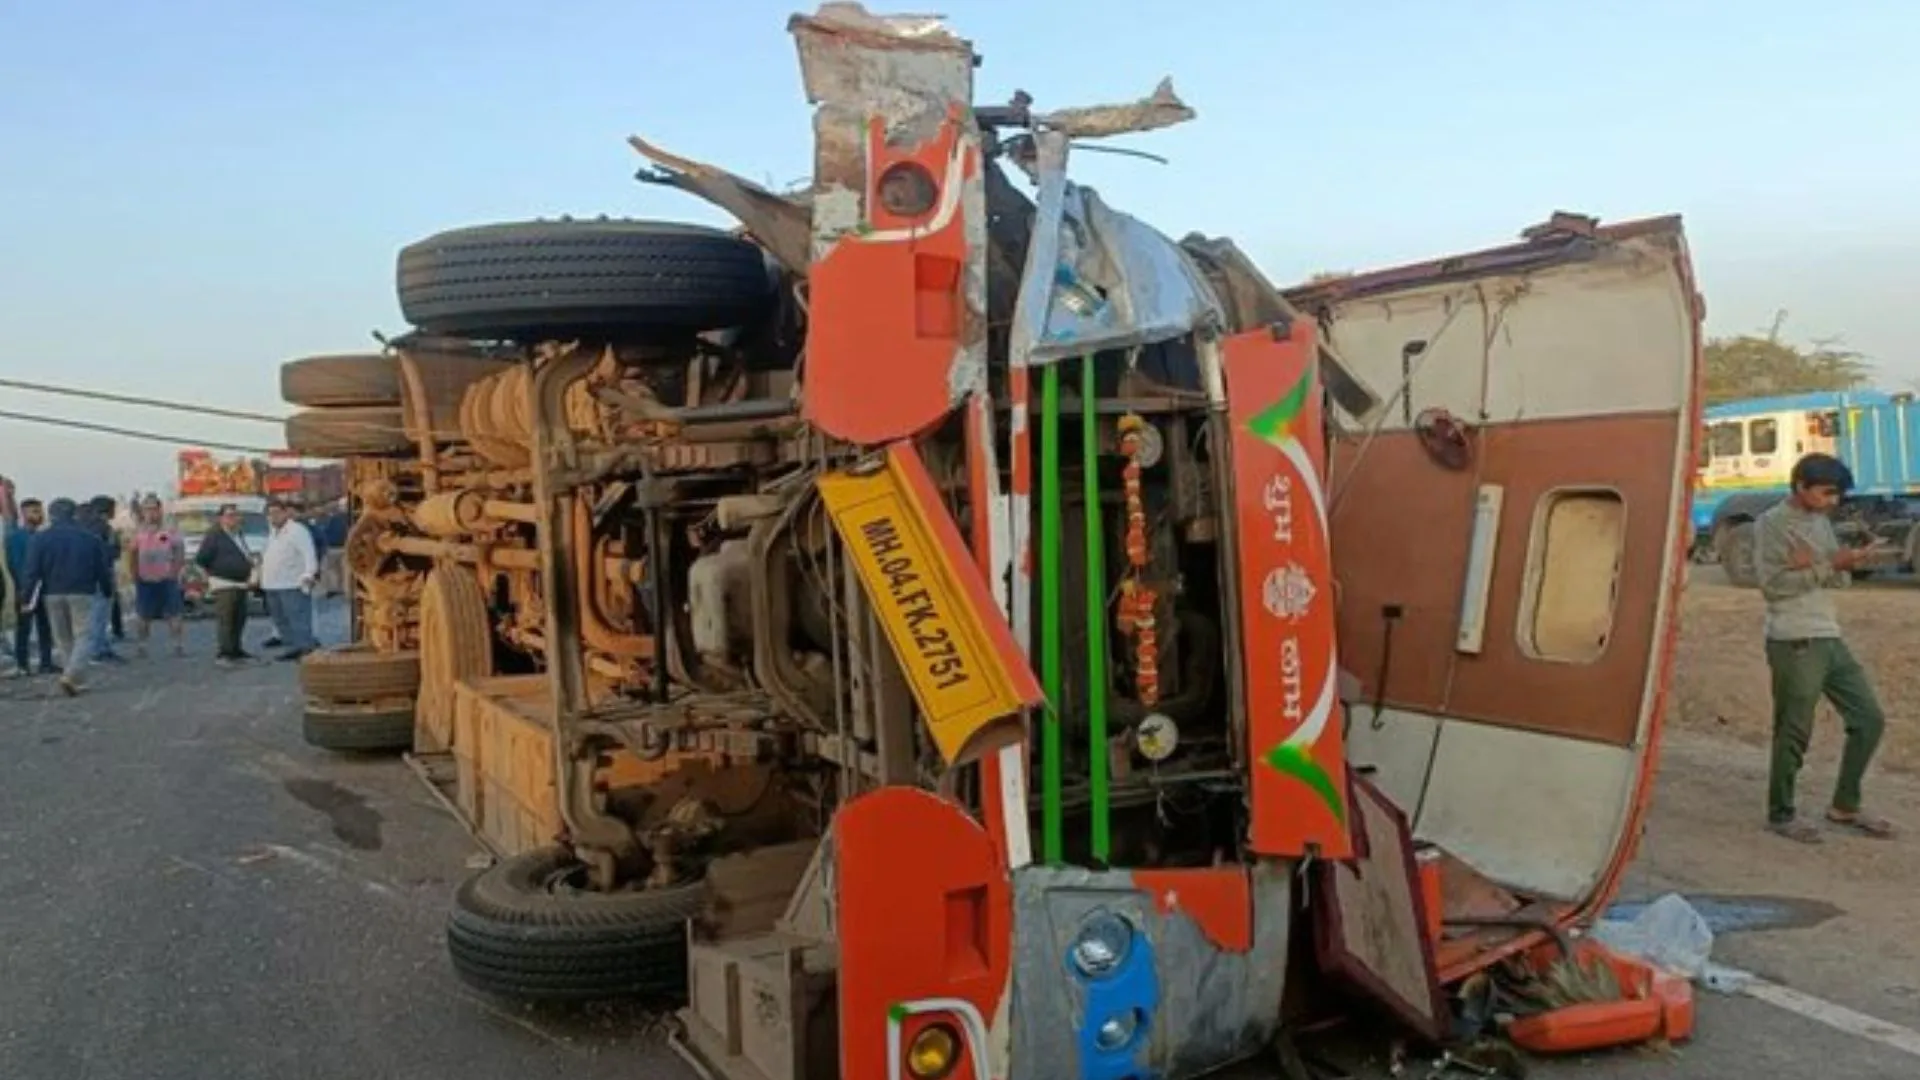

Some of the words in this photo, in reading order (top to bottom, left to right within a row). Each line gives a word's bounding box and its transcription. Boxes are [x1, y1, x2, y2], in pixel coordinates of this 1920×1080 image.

[860, 517, 969, 689] MH.04.FK.2751
[1264, 474, 1292, 544] शुभ
[1281, 636, 1301, 722] लाभ
